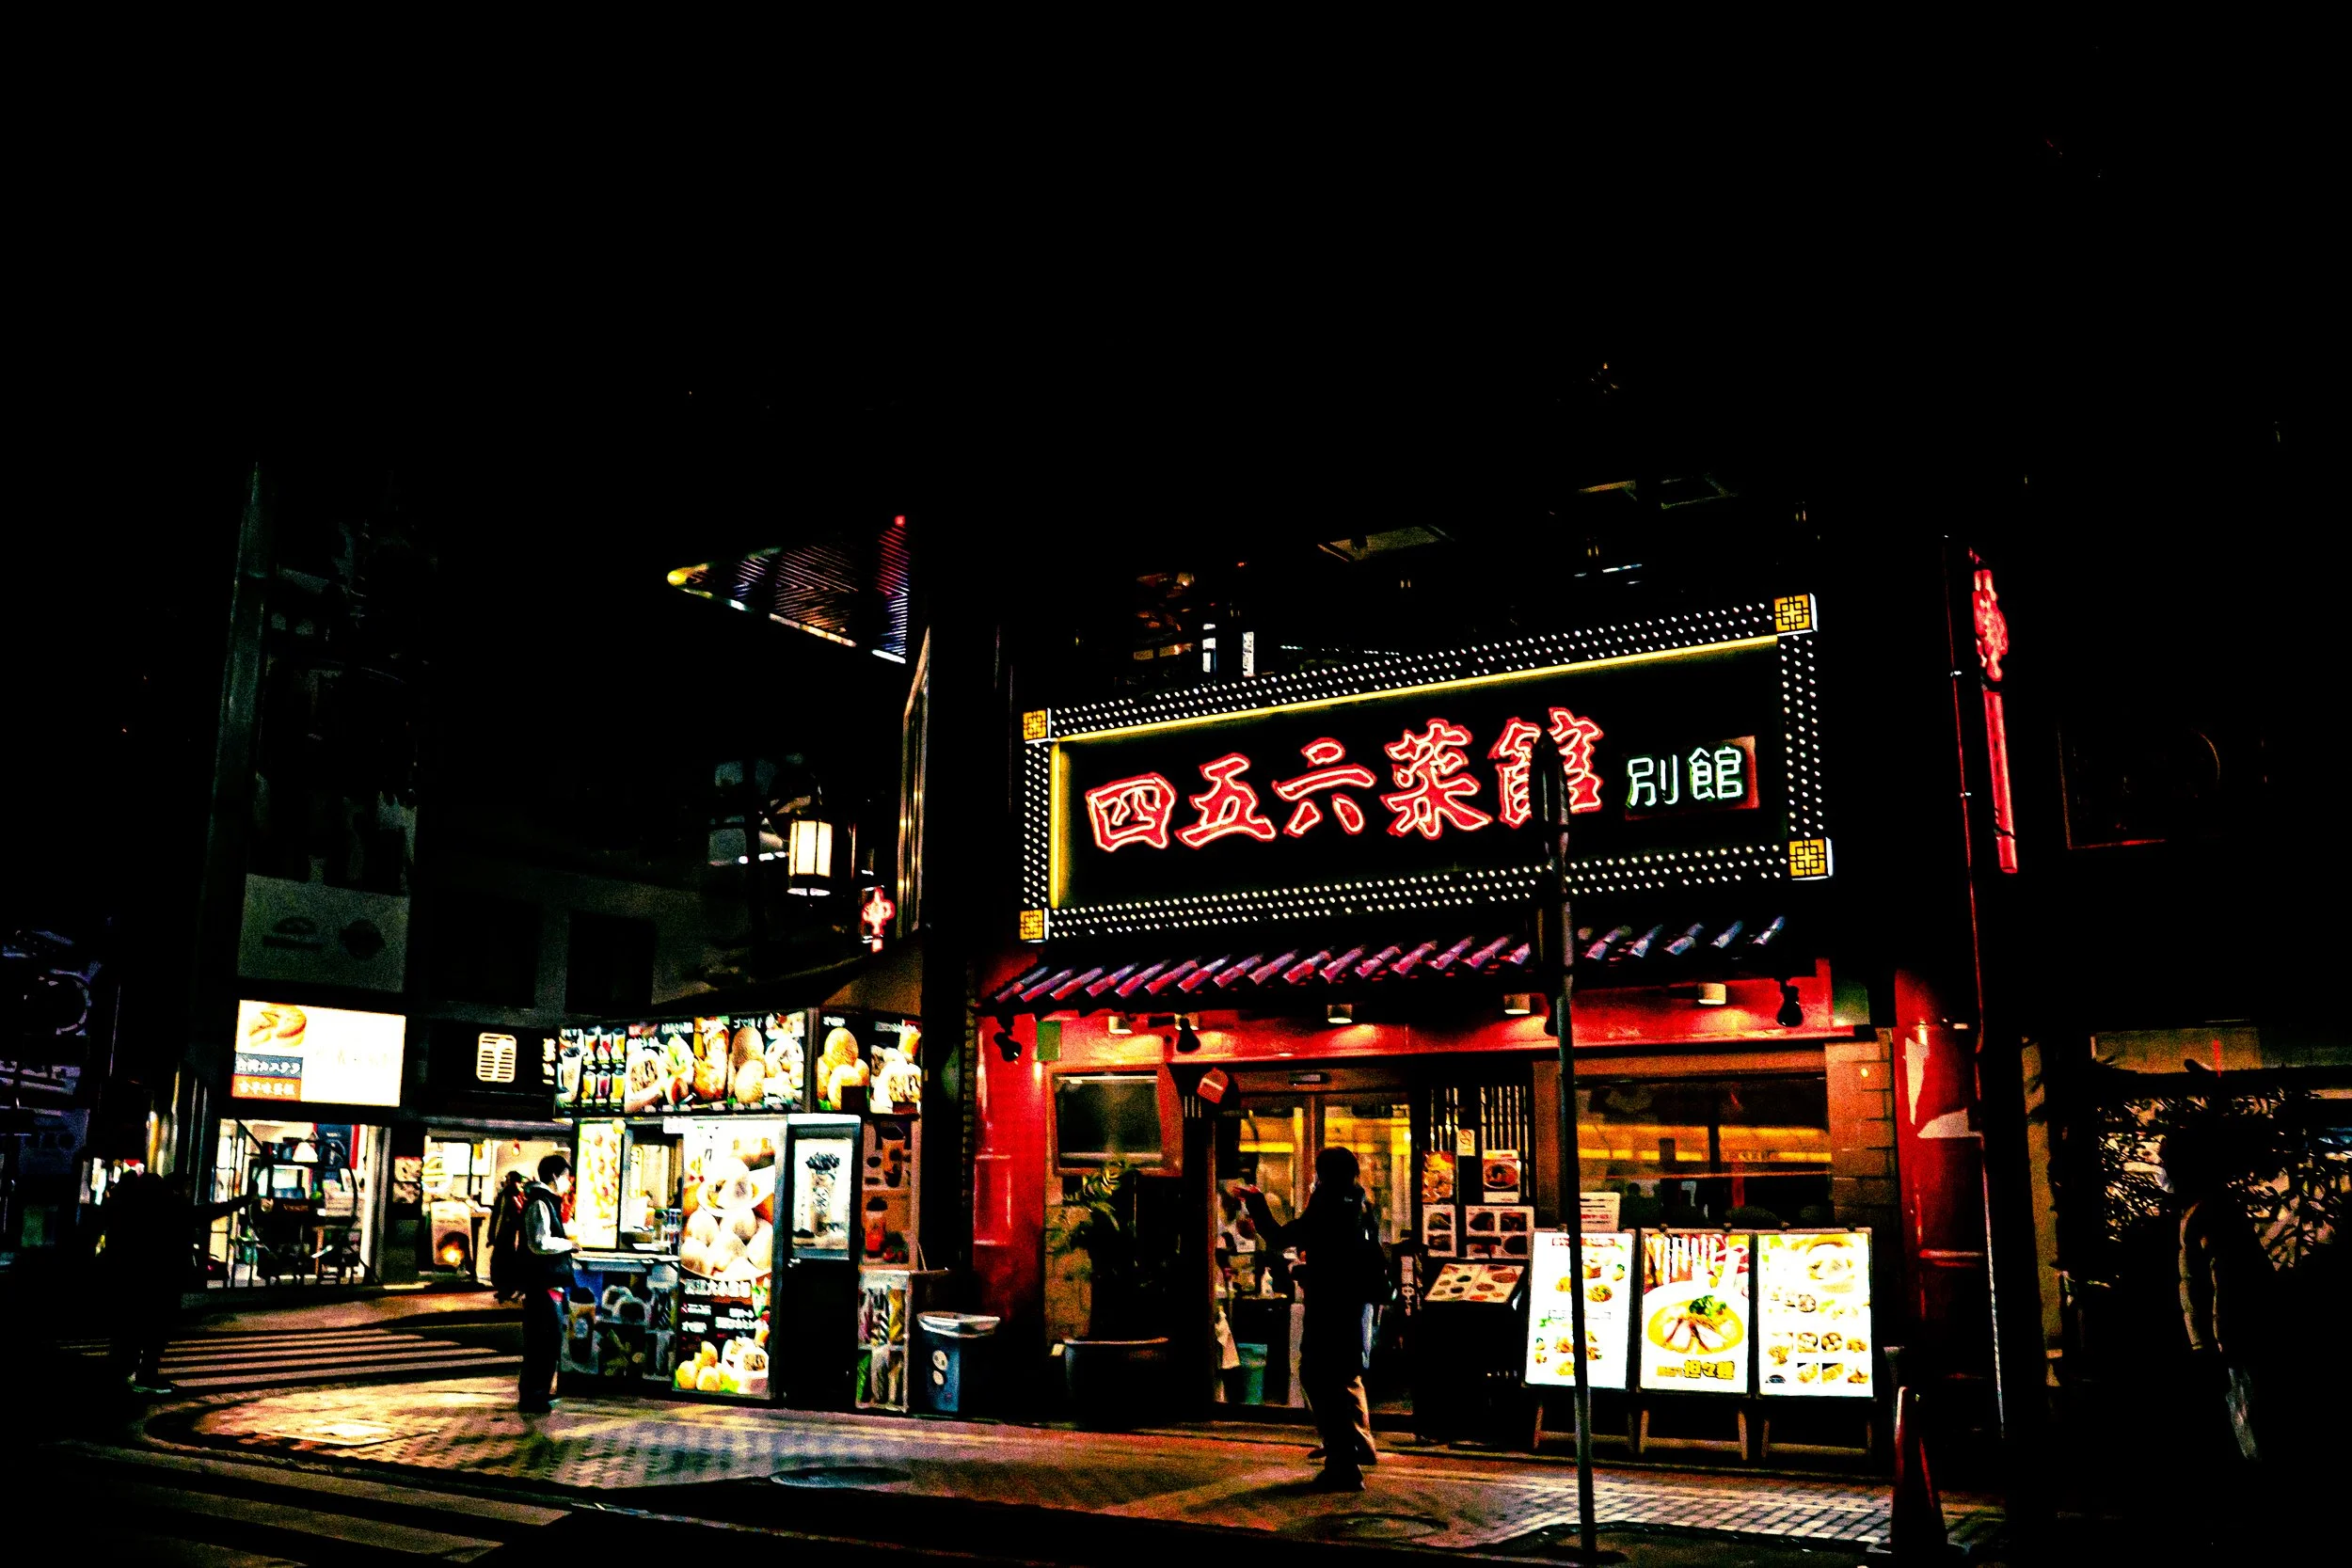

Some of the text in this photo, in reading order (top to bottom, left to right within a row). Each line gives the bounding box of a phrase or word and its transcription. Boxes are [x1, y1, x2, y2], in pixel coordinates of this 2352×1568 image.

[1085, 707, 1743, 853] 四五六菜館 別館
